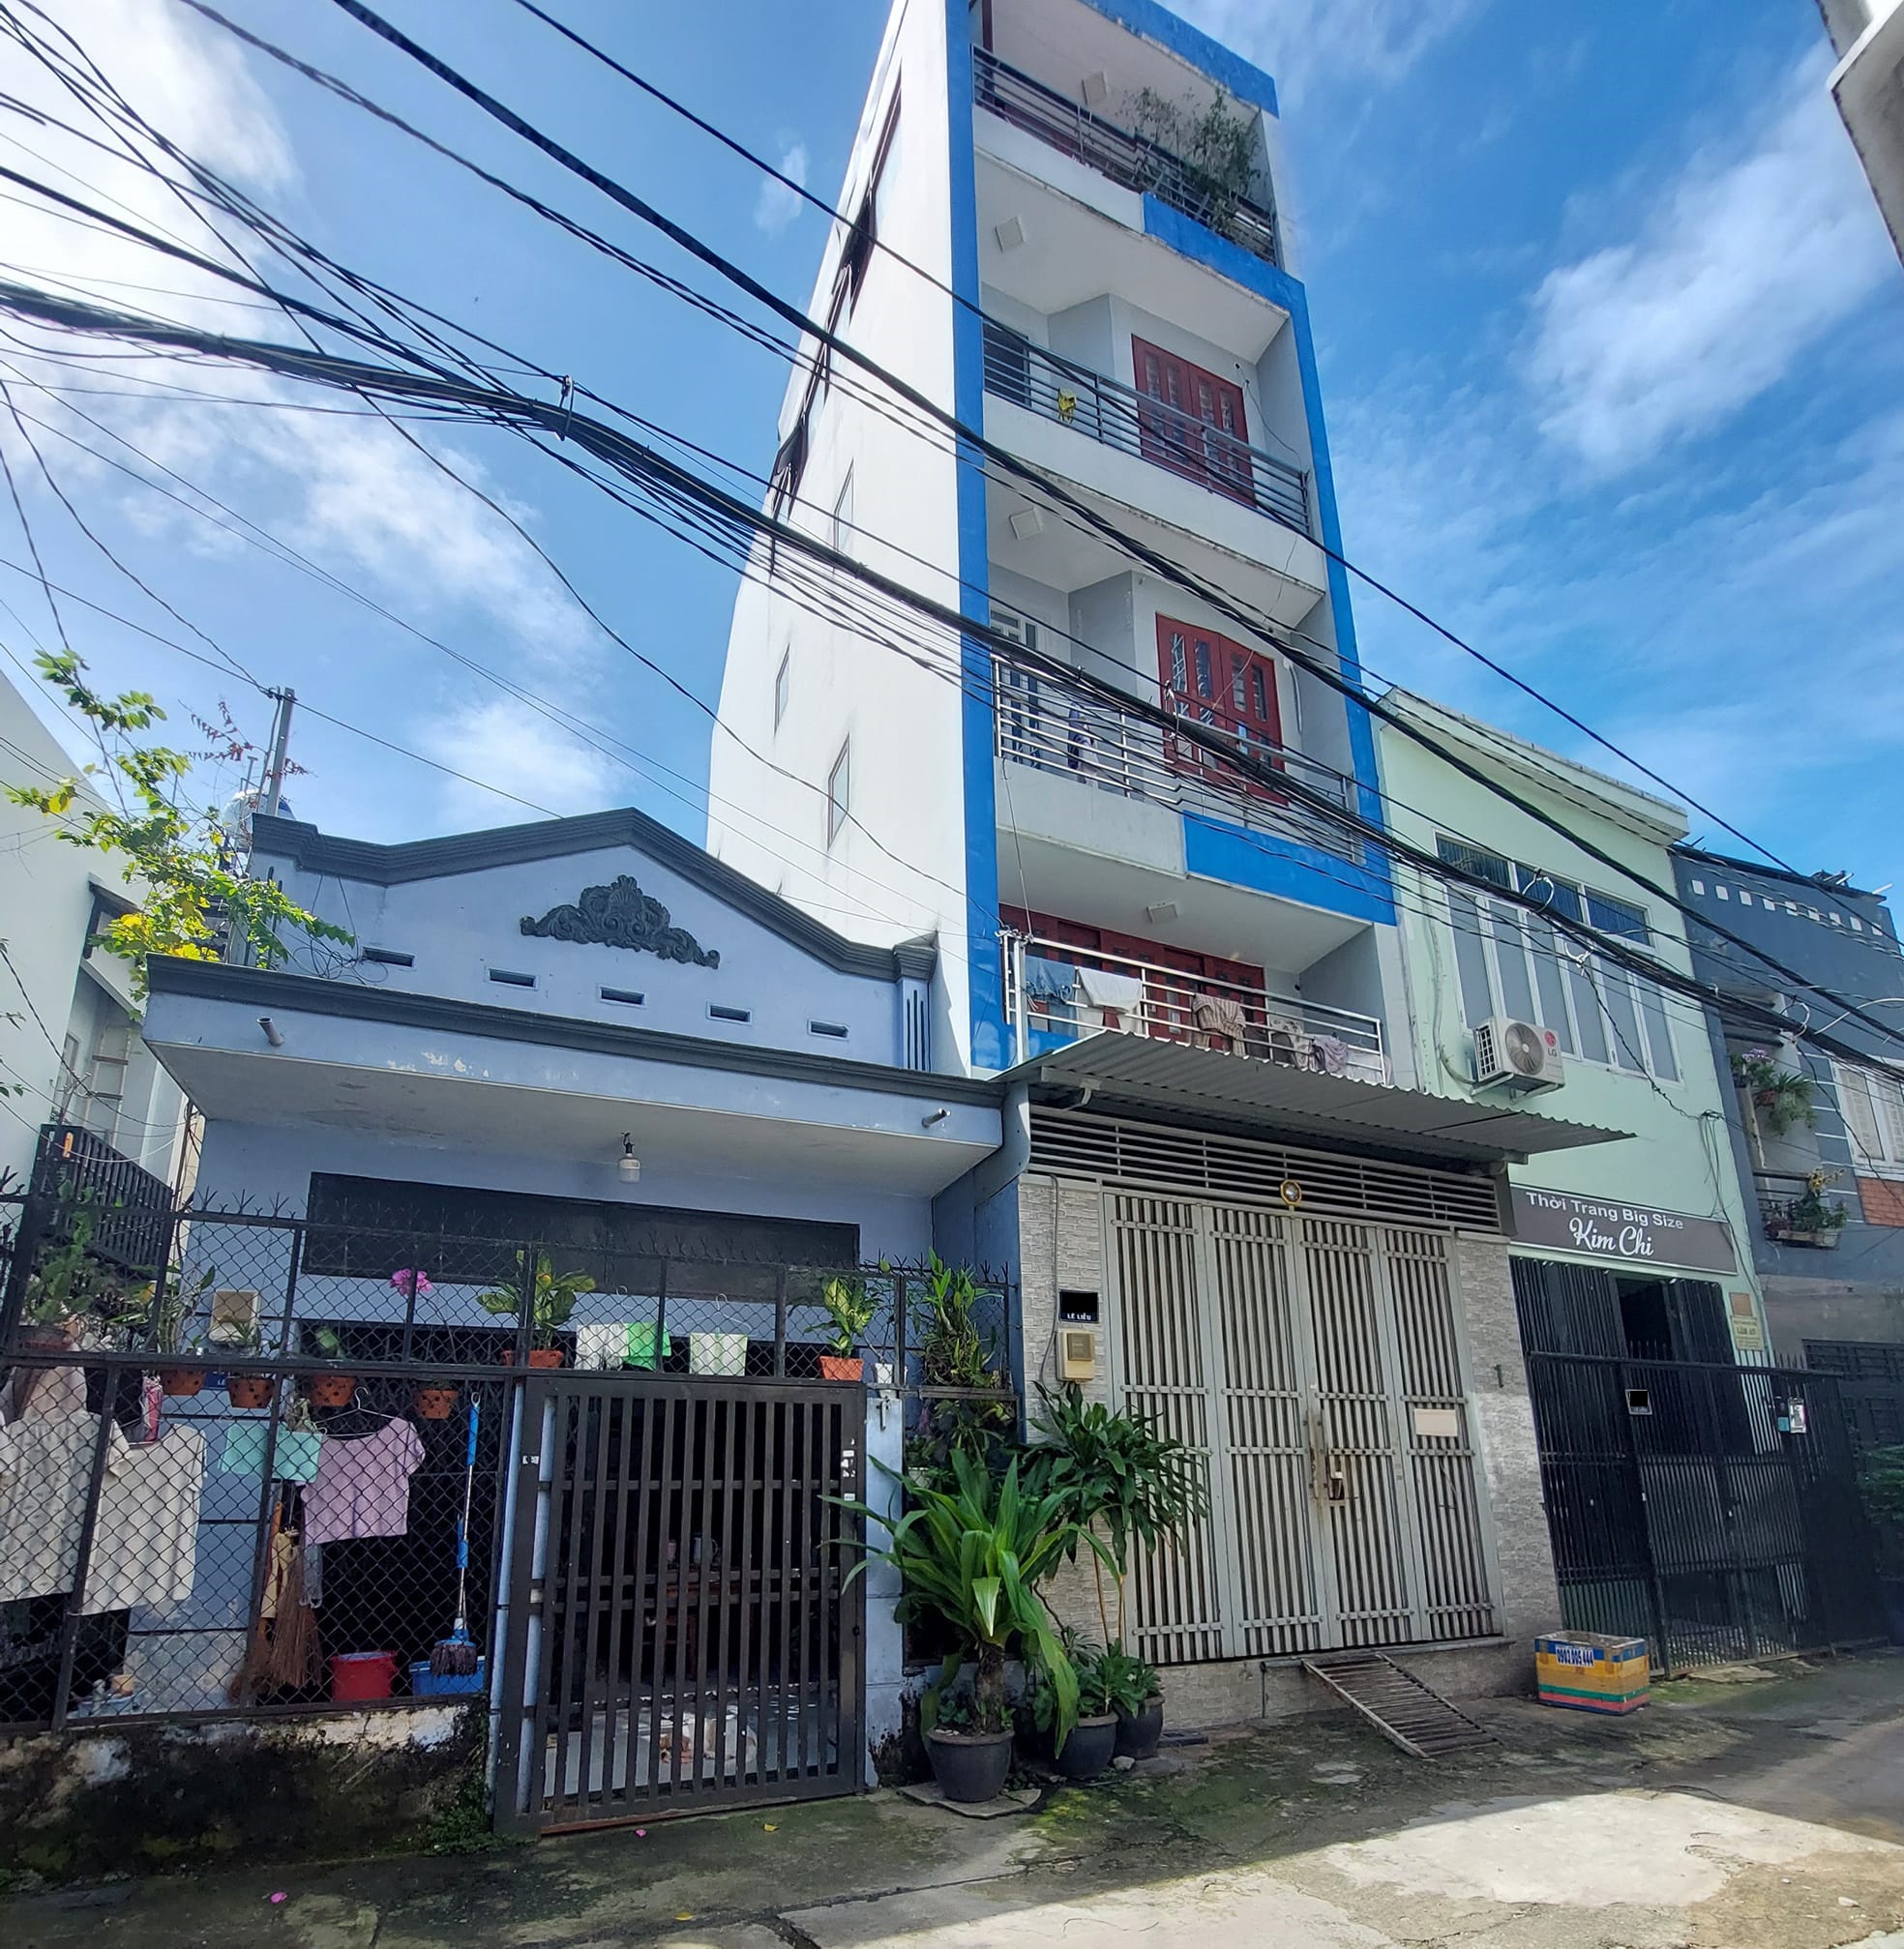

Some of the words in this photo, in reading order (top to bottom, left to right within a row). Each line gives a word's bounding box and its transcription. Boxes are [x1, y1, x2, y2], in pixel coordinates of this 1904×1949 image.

[1548, 1048, 1558, 1057] LG
[1526, 1192, 1566, 1211] Thời
[1570, 1199, 1619, 1222] Trang
[1622, 1208, 1649, 1226] Big
[1652, 1214, 1684, 1229] Size
[1569, 1217, 1617, 1251] Kim
[1619, 1226, 1654, 1255] Chi
